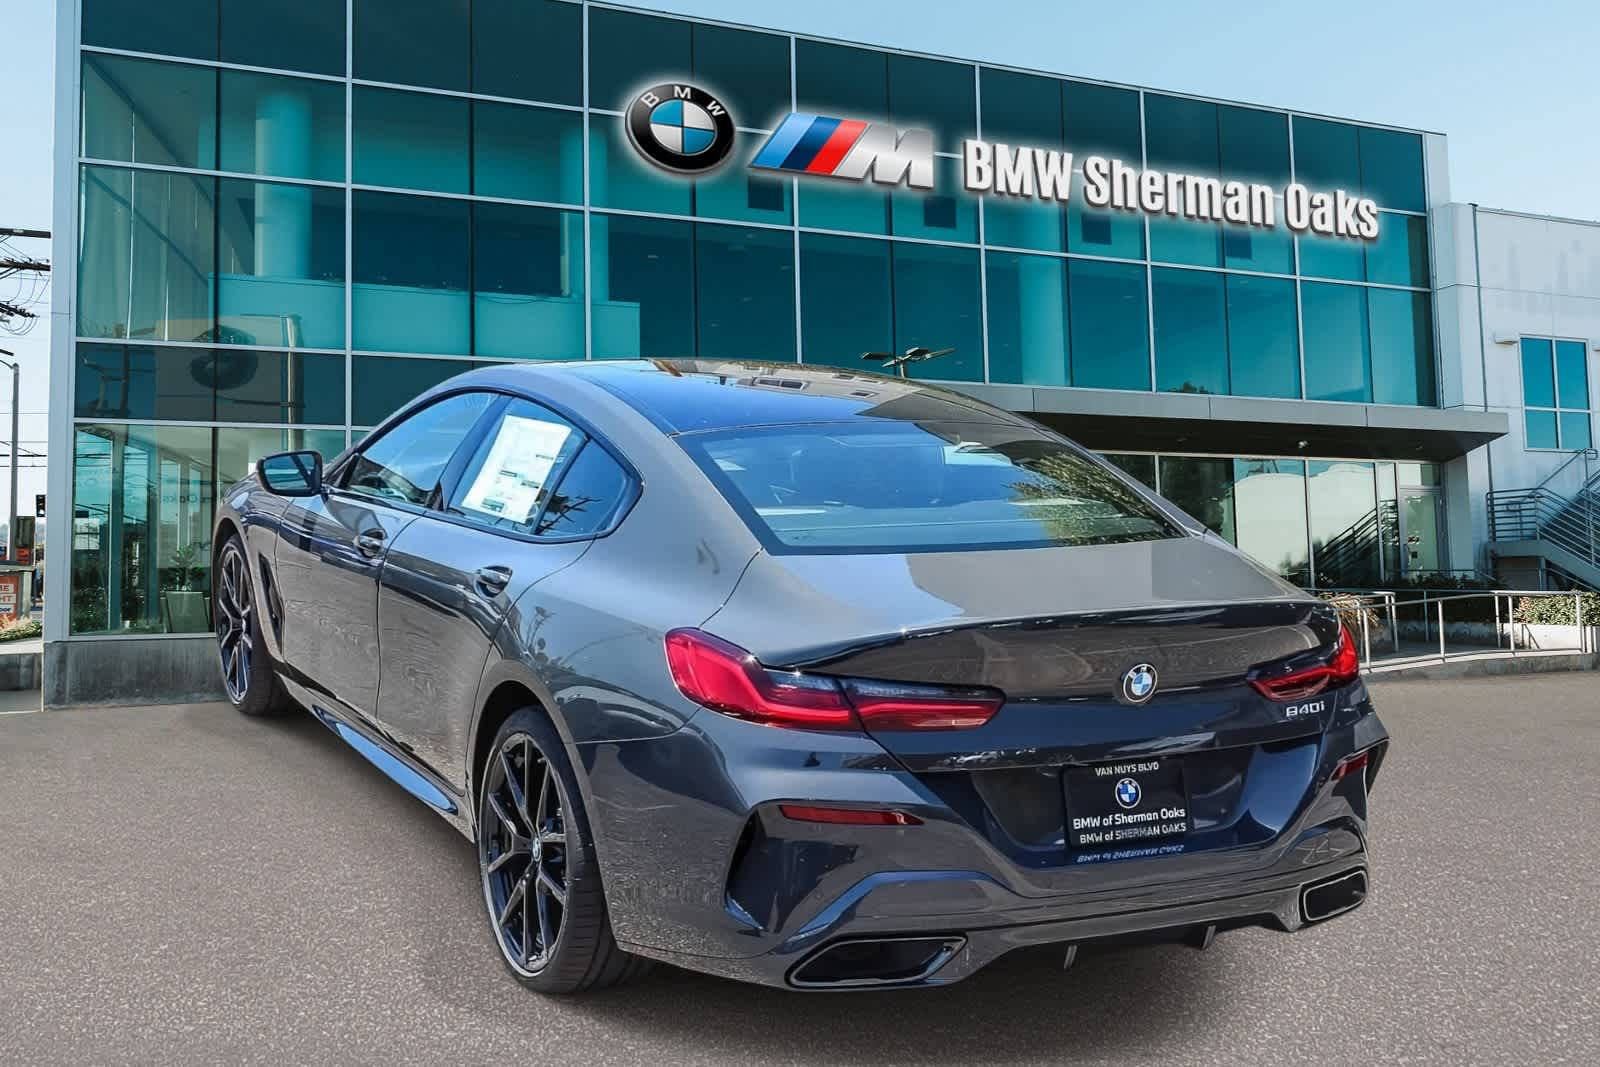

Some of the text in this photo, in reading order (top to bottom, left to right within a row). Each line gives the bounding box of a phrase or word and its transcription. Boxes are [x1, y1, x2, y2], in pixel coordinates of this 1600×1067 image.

[641, 85, 727, 118] BMW
[964, 139, 1379, 240] BMW Sherman Oaks
[1286, 700, 1325, 717] 840i
[1095, 761, 1160, 777] VAN NUYS BLVD
[1073, 807, 1186, 830] BMW of Sherman Oaks
[1080, 822, 1187, 844] BMW of SHERMAN OAKS
